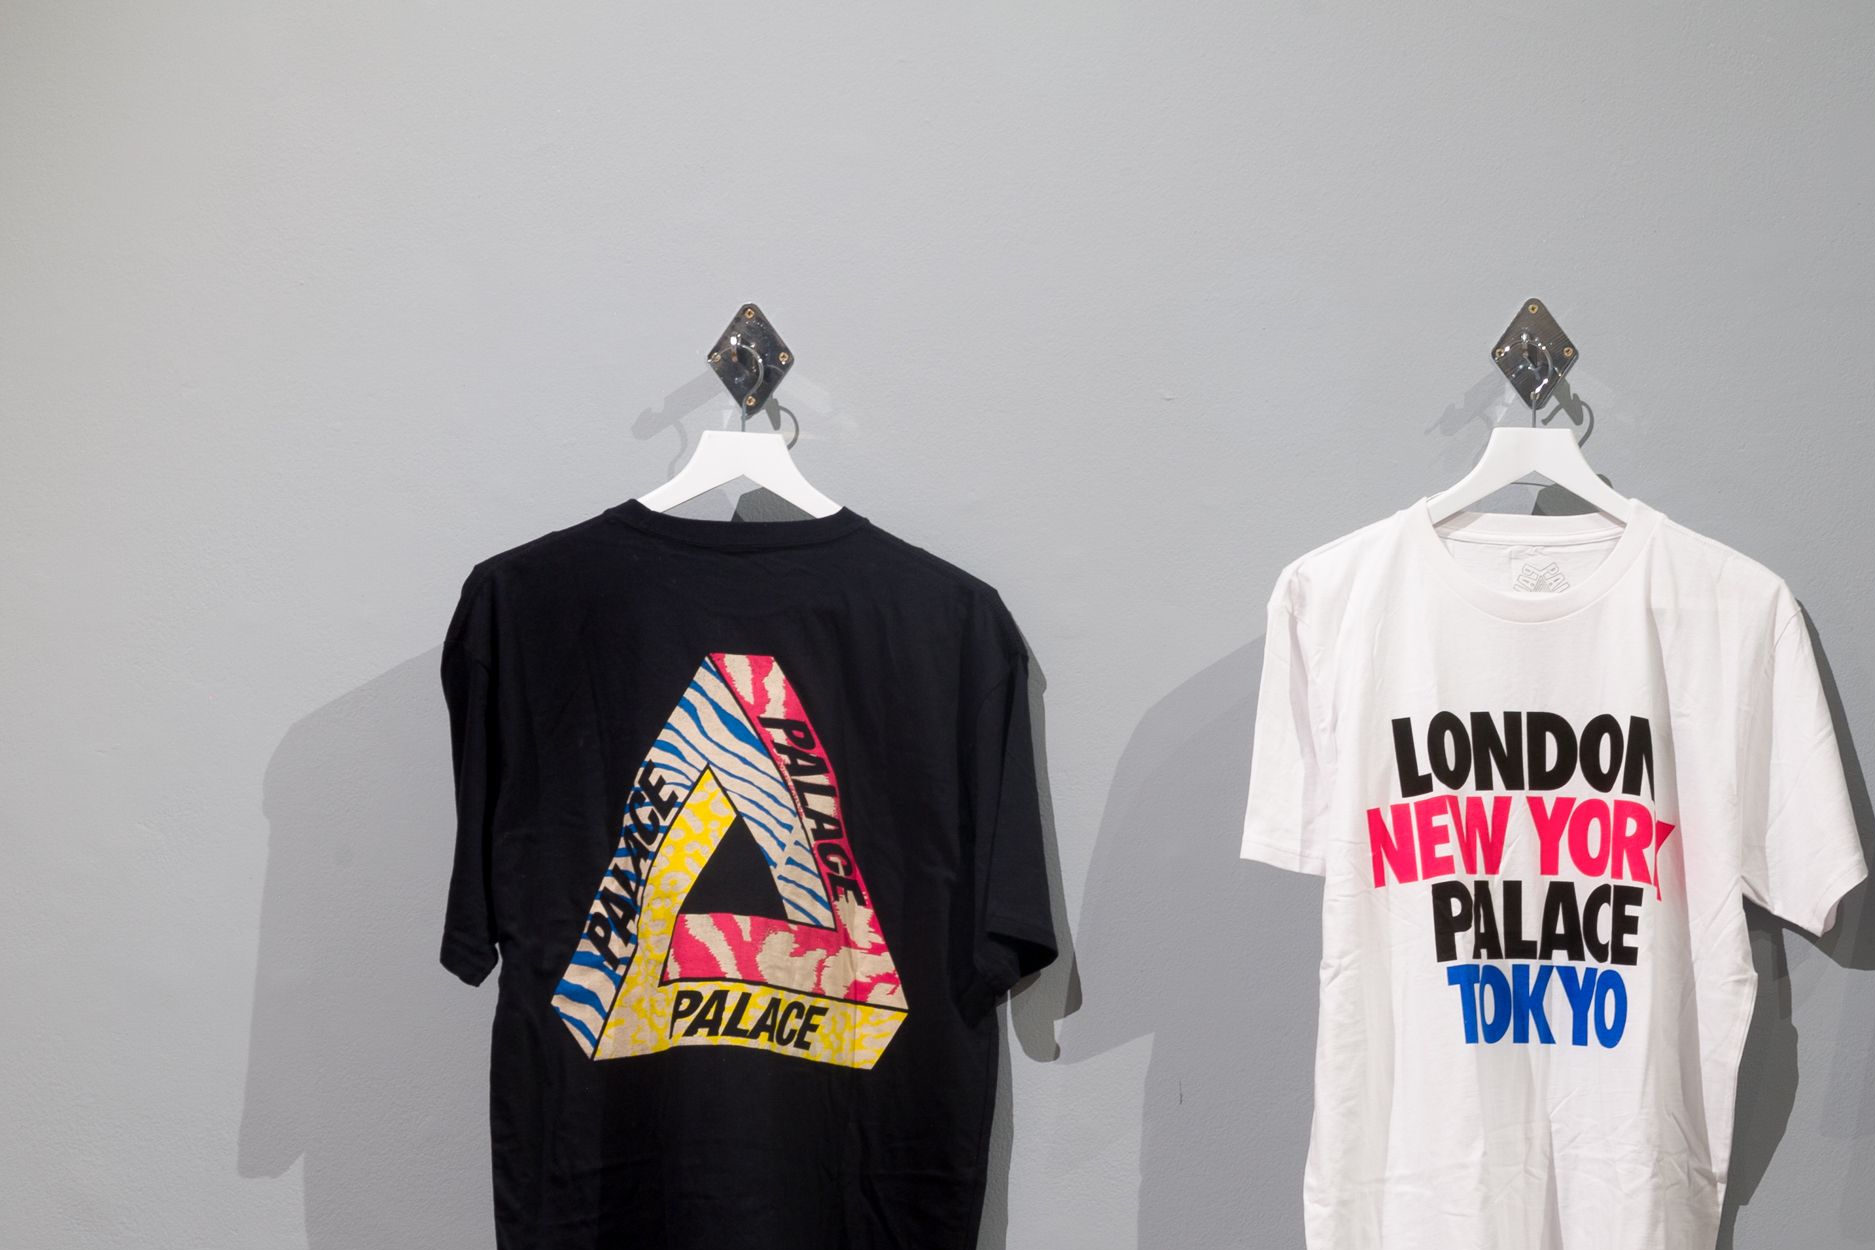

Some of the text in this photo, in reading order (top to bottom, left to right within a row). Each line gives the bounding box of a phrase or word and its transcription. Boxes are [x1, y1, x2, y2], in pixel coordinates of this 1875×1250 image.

[1392, 711, 1655, 800] LONDON
[756, 716, 865, 907] PALACE
[1367, 795, 1677, 901] NEW YORK
[586, 759, 680, 969] PALACE
[1432, 880, 1643, 966] PALACE
[670, 990, 828, 1050] PALACE
[1447, 964, 1627, 1049] TOKYO
